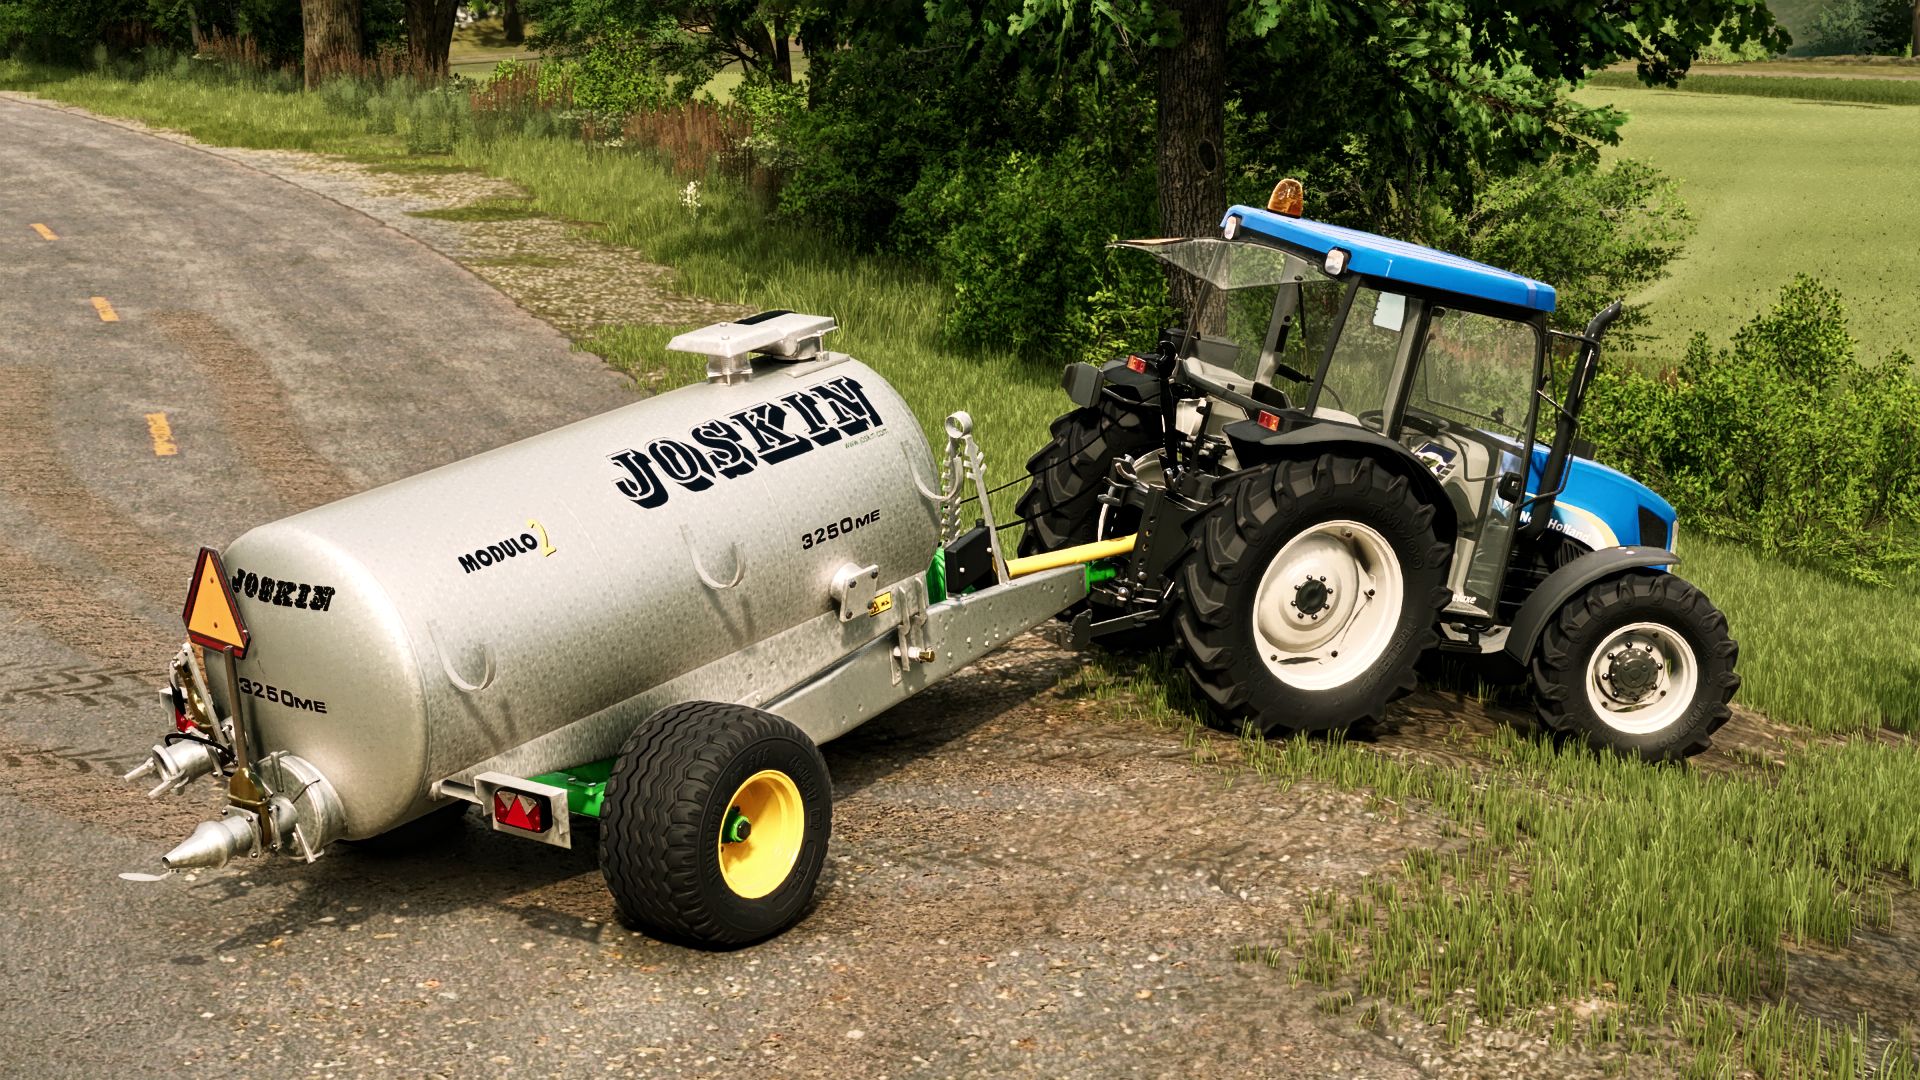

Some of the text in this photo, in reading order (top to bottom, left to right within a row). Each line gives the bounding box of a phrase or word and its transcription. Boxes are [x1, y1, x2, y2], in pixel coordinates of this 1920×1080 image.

[606, 376, 884, 509] JOSKIN
[1547, 518, 1591, 541] Holland
[458, 533, 538, 574] MODULO
[231, 568, 336, 612] JOSKIN
